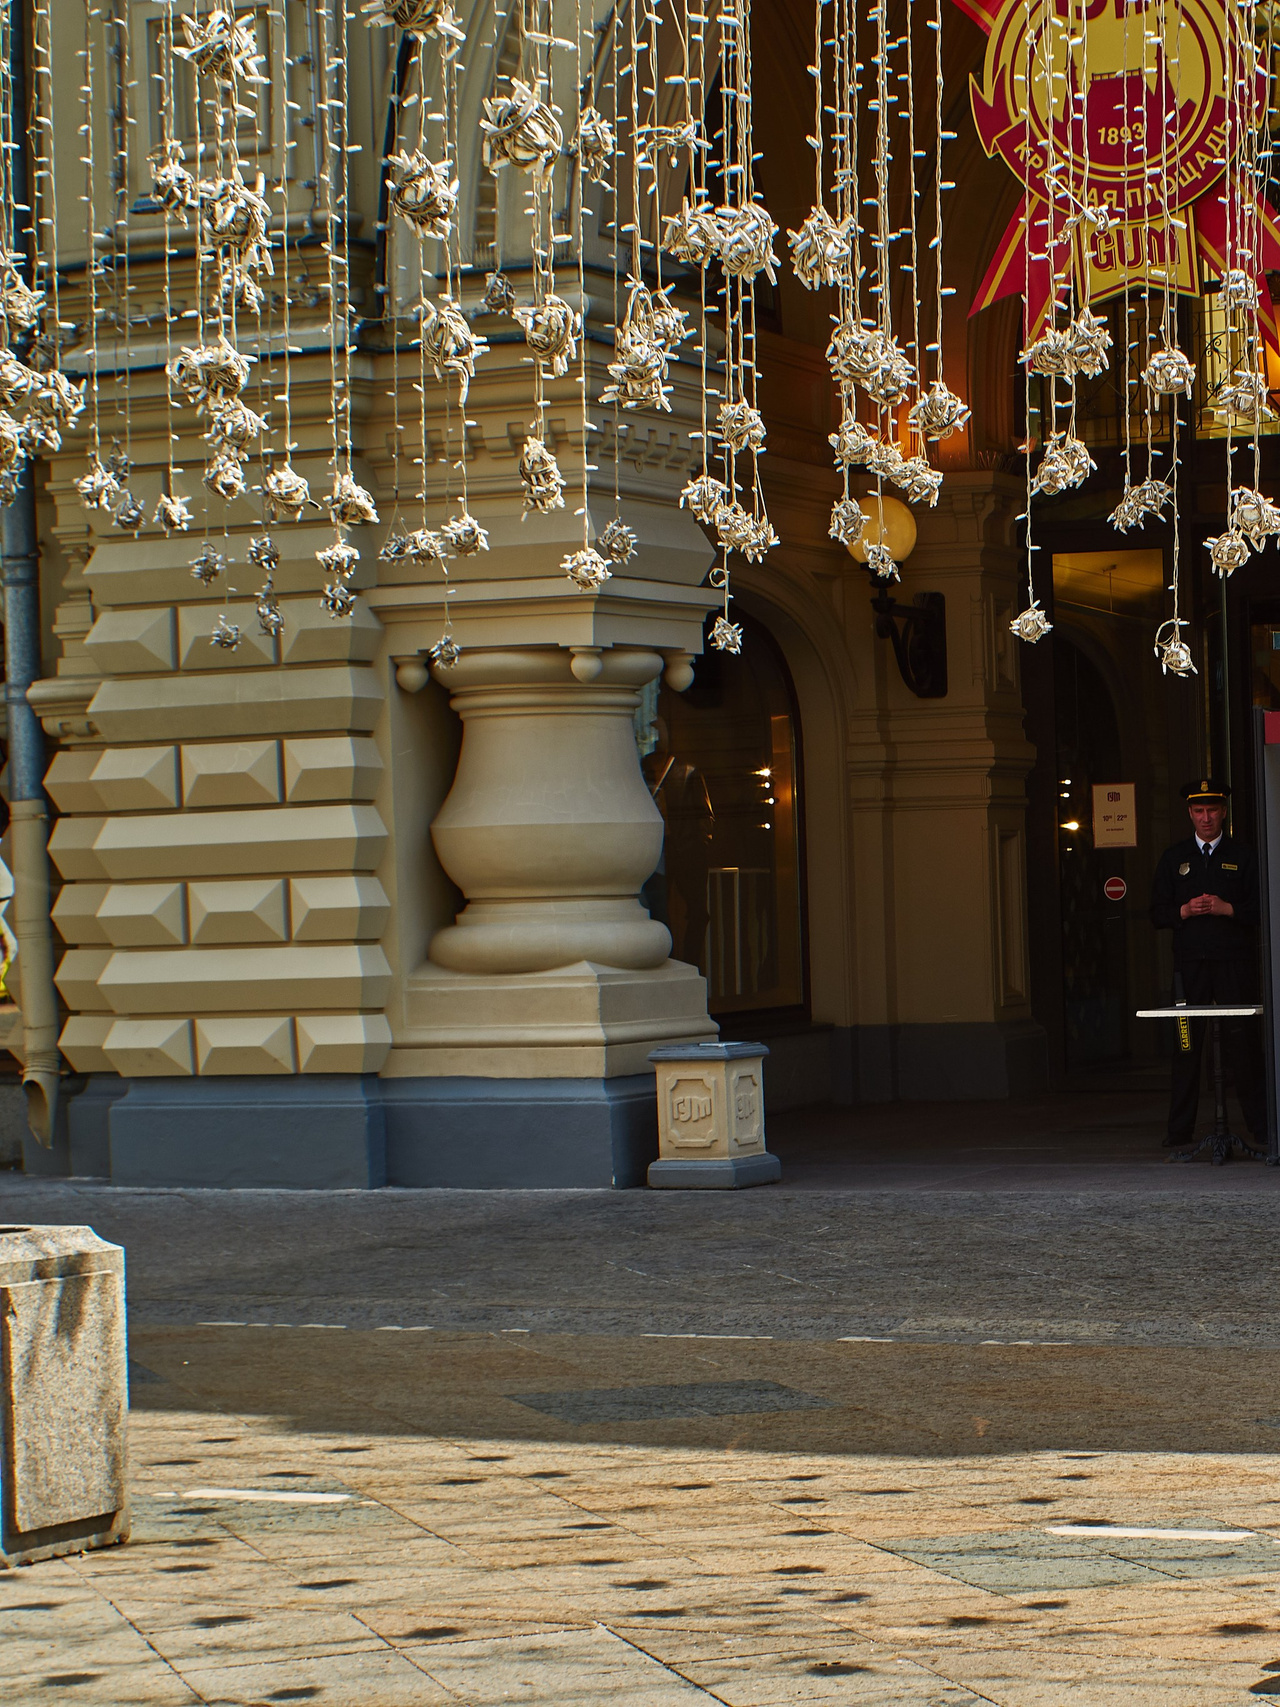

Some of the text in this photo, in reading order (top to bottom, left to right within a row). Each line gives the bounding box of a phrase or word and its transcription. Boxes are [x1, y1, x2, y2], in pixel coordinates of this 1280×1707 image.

[1098, 122, 1145, 146] 1893
[1013, 119, 1233, 210] КРАСНАЯ ПЛОЩАДЬ
[1089, 224, 1181, 273] GUM
[672, 1096, 713, 1122] ГУМ
